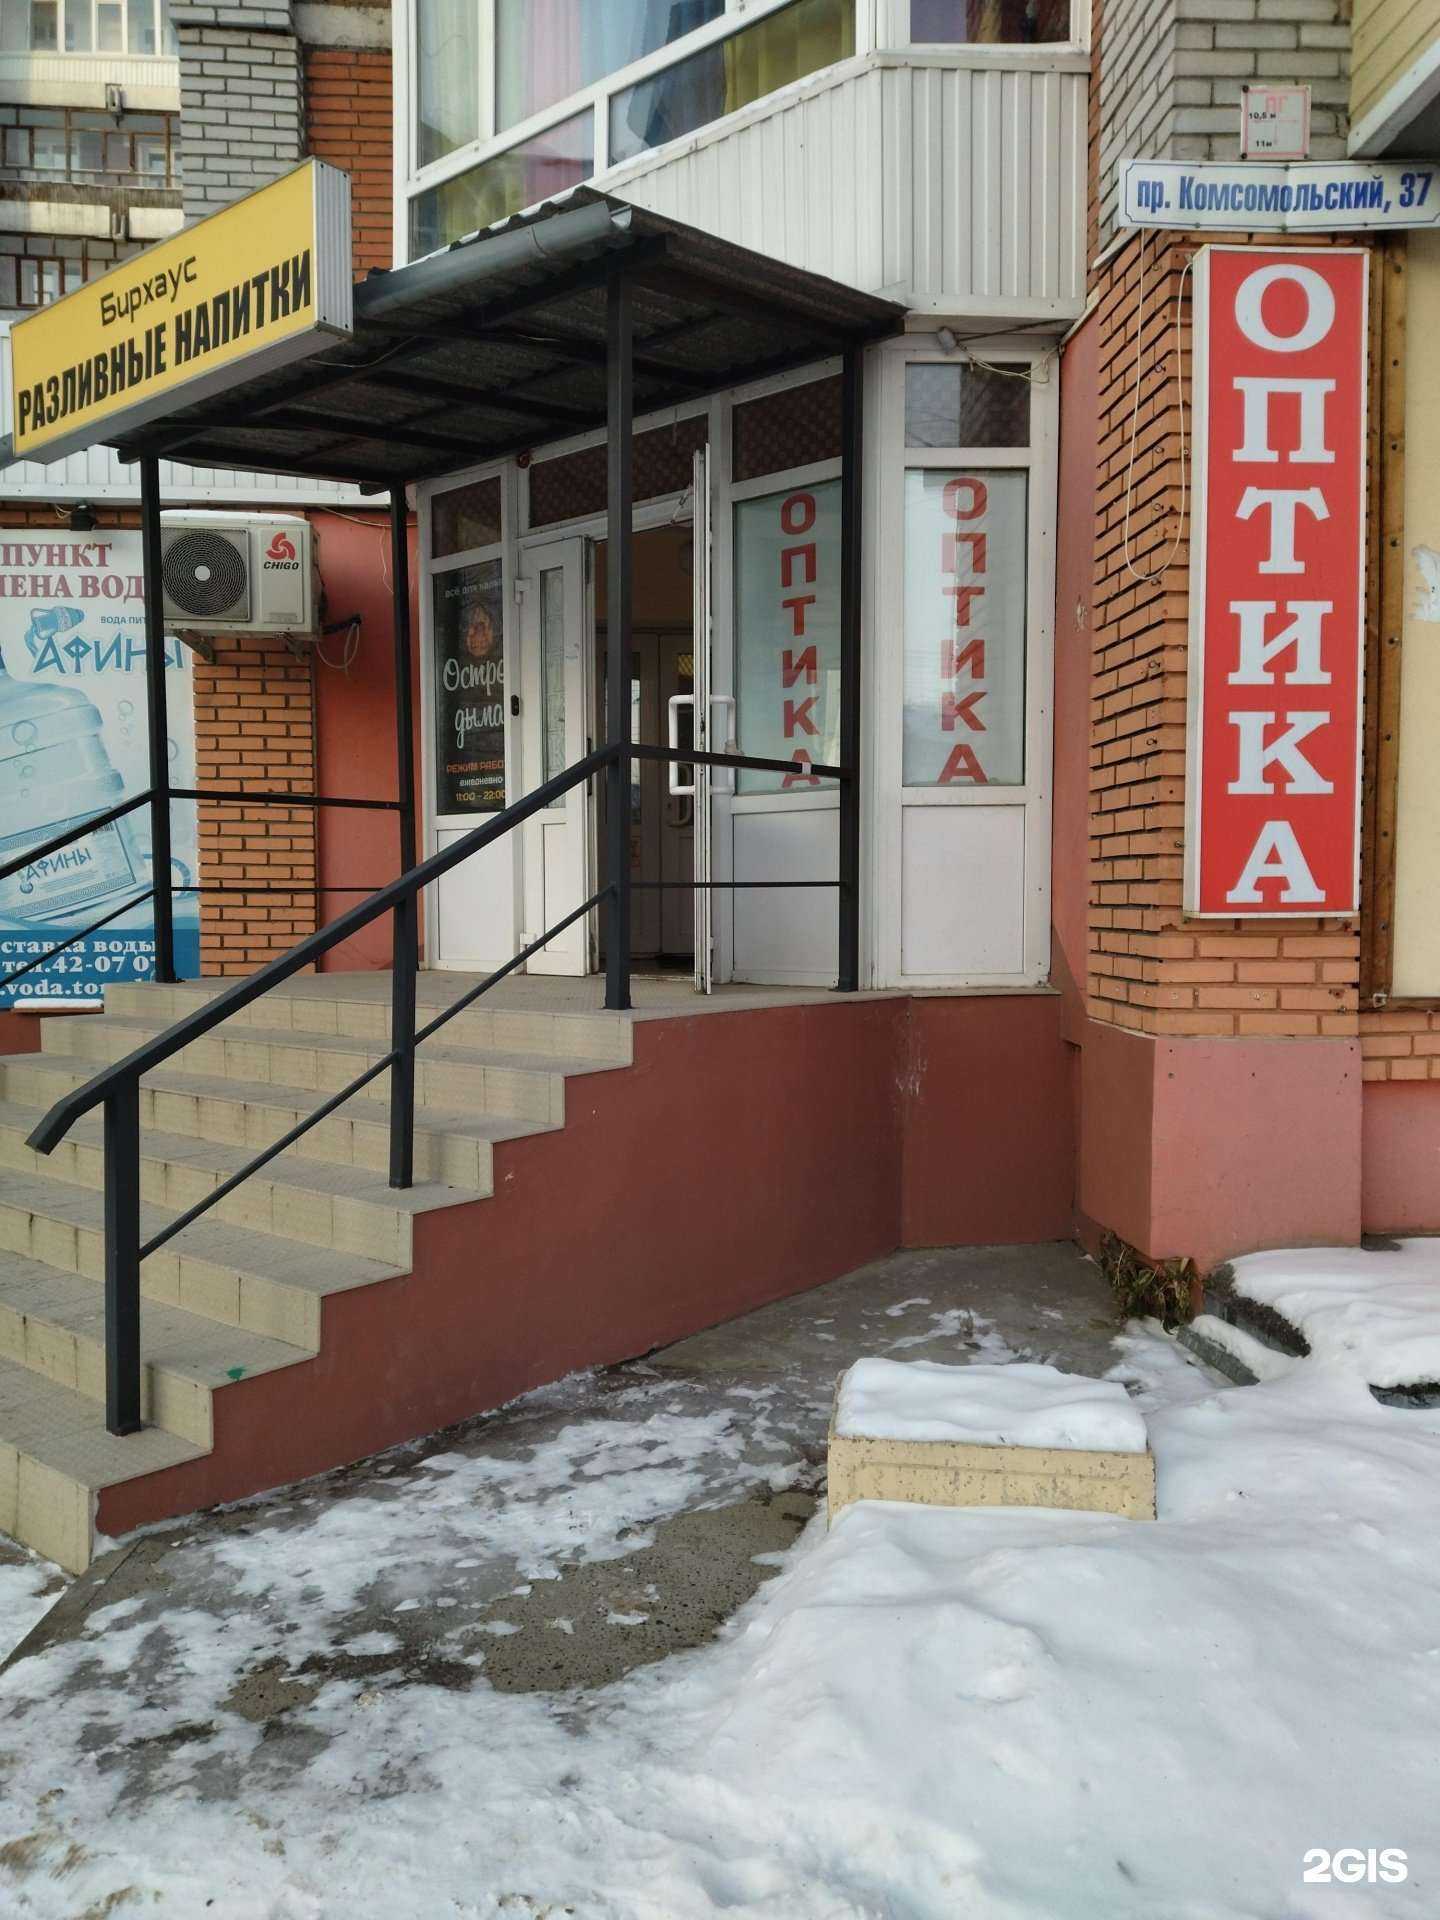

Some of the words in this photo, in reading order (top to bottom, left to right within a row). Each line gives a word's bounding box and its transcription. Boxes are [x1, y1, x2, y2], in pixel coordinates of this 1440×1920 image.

[1136, 179, 1171, 214] пр.
[1179, 173, 1392, 214] Комсомольский,
[1399, 171, 1434, 208] 37
[18, 321, 167, 437] РАЗЛИВНЫЕ
[174, 248, 311, 367] НАПИТКИ
[100, 255, 198, 327] Бирхаус
[0, 543, 113, 568] ПУНКТ
[263, 561, 300, 570] CHIGO
[1225, 263, 1337, 904] ОПТИКА
[780, 492, 821, 789] ОПТИКА
[937, 477, 988, 785] ОПТИКА
